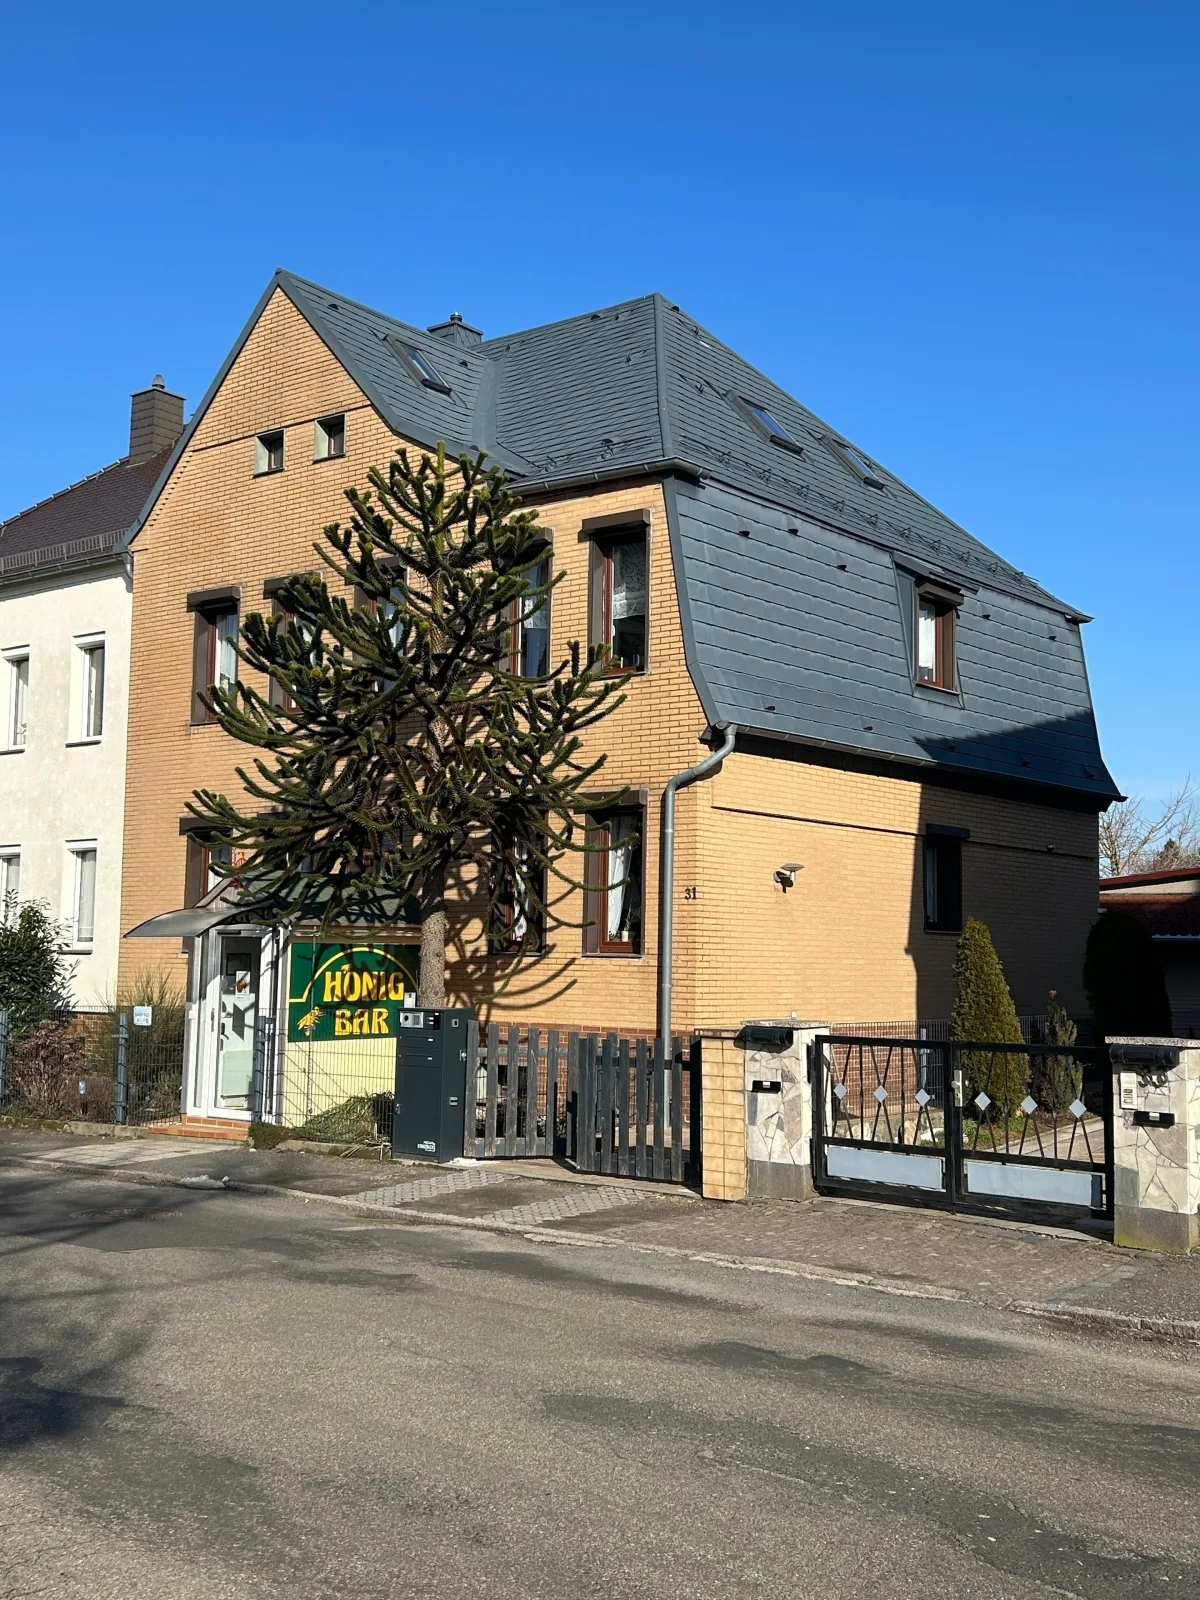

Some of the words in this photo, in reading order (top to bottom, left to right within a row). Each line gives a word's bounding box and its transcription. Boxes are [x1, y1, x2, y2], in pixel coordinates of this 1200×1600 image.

[684, 887, 697, 900] 31
[323, 971, 404, 1002] HONIG
[334, 1008, 389, 1036] BAR
